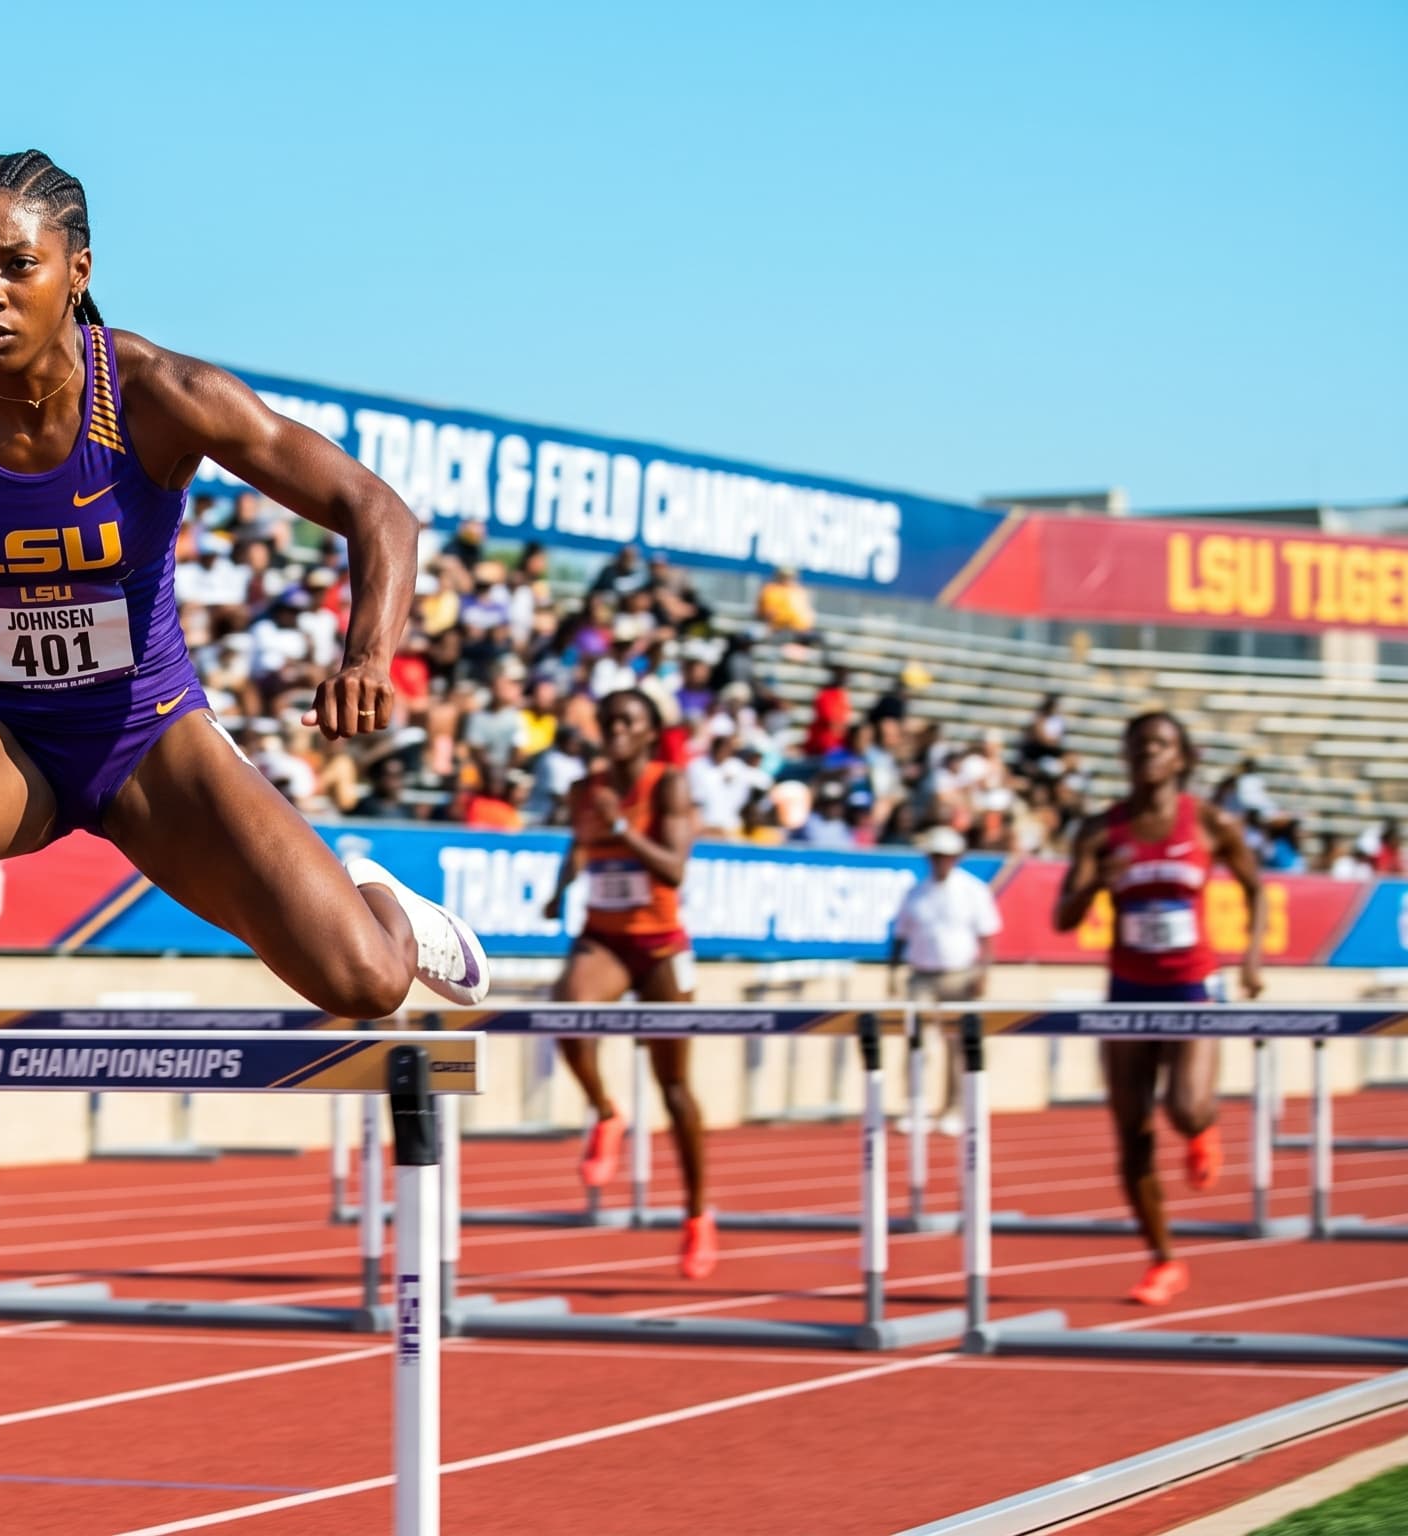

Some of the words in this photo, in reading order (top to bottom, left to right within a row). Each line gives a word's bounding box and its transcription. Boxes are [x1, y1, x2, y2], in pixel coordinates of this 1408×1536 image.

[354, 408, 495, 523] TRACK
[496, 434, 532, 527] &
[533, 440, 642, 543] FIELD
[643, 459, 901, 584] CHAMPIONSHIPS
[1168, 532, 1275, 618] LSU
[20, 585, 73, 604] LSU
[8, 608, 95, 631] JOHNSEN
[12, 631, 99, 678] 401
[7, 1048, 244, 1078] CHAMPIONSHIPS
